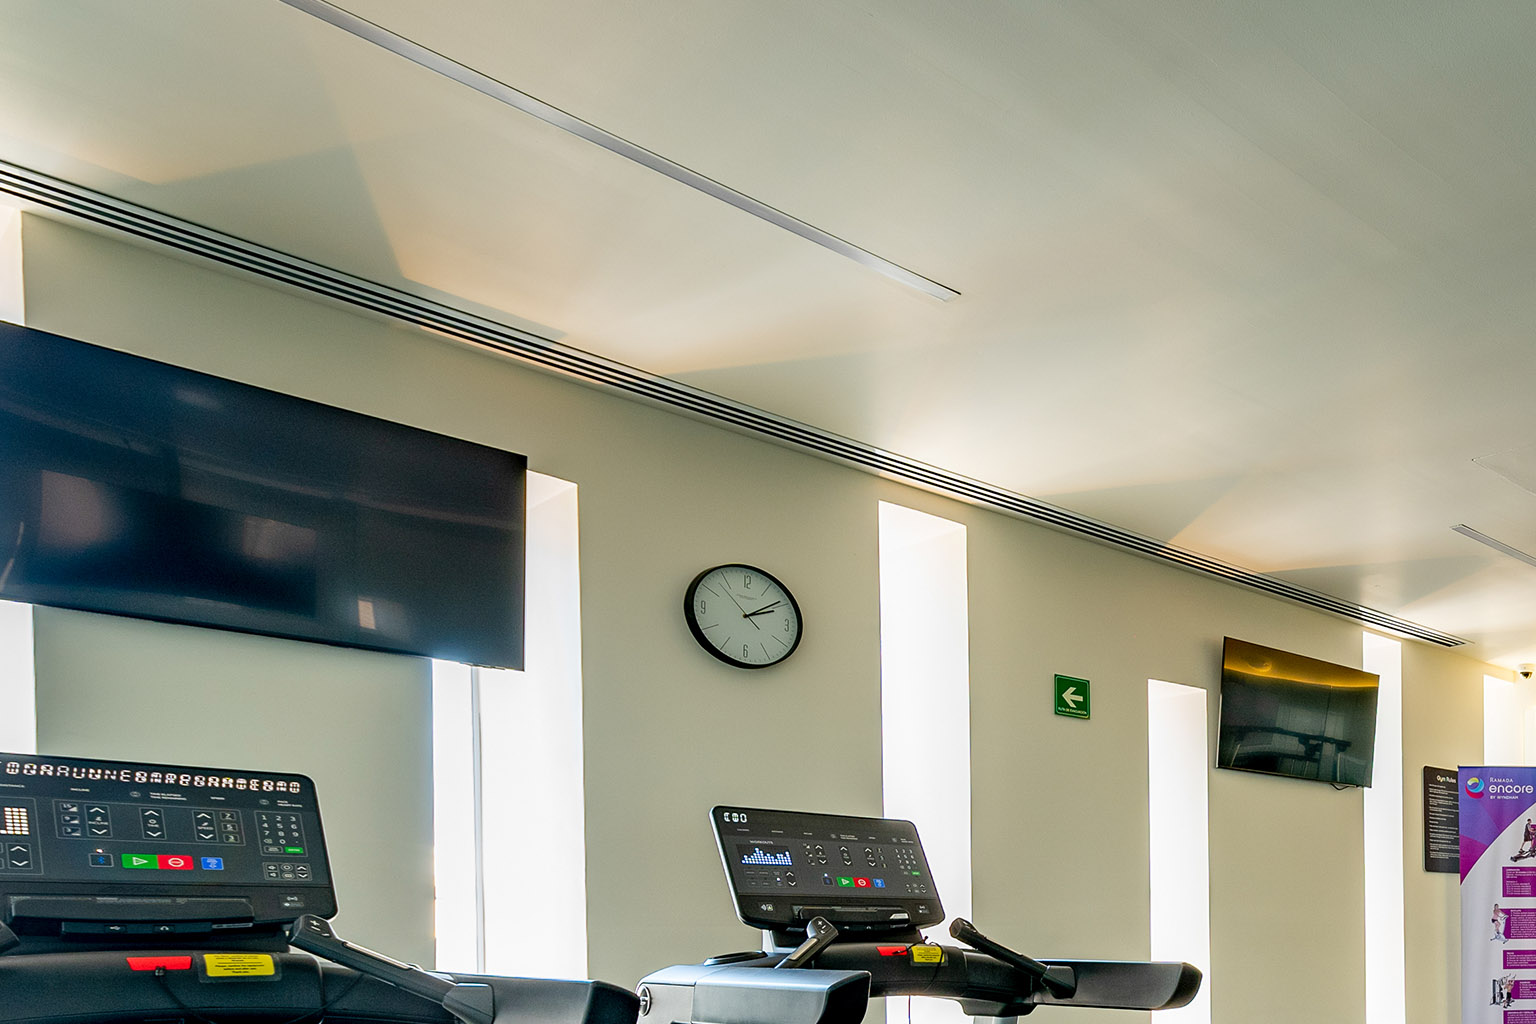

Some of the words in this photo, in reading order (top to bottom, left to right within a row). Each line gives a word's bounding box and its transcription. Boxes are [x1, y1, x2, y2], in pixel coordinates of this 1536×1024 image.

[743, 574, 752, 590] 12
[700, 600, 706, 615] 9
[784, 618, 790, 632] 3
[742, 644, 749, 658] 6
[1488, 783, 1534, 794] encore
